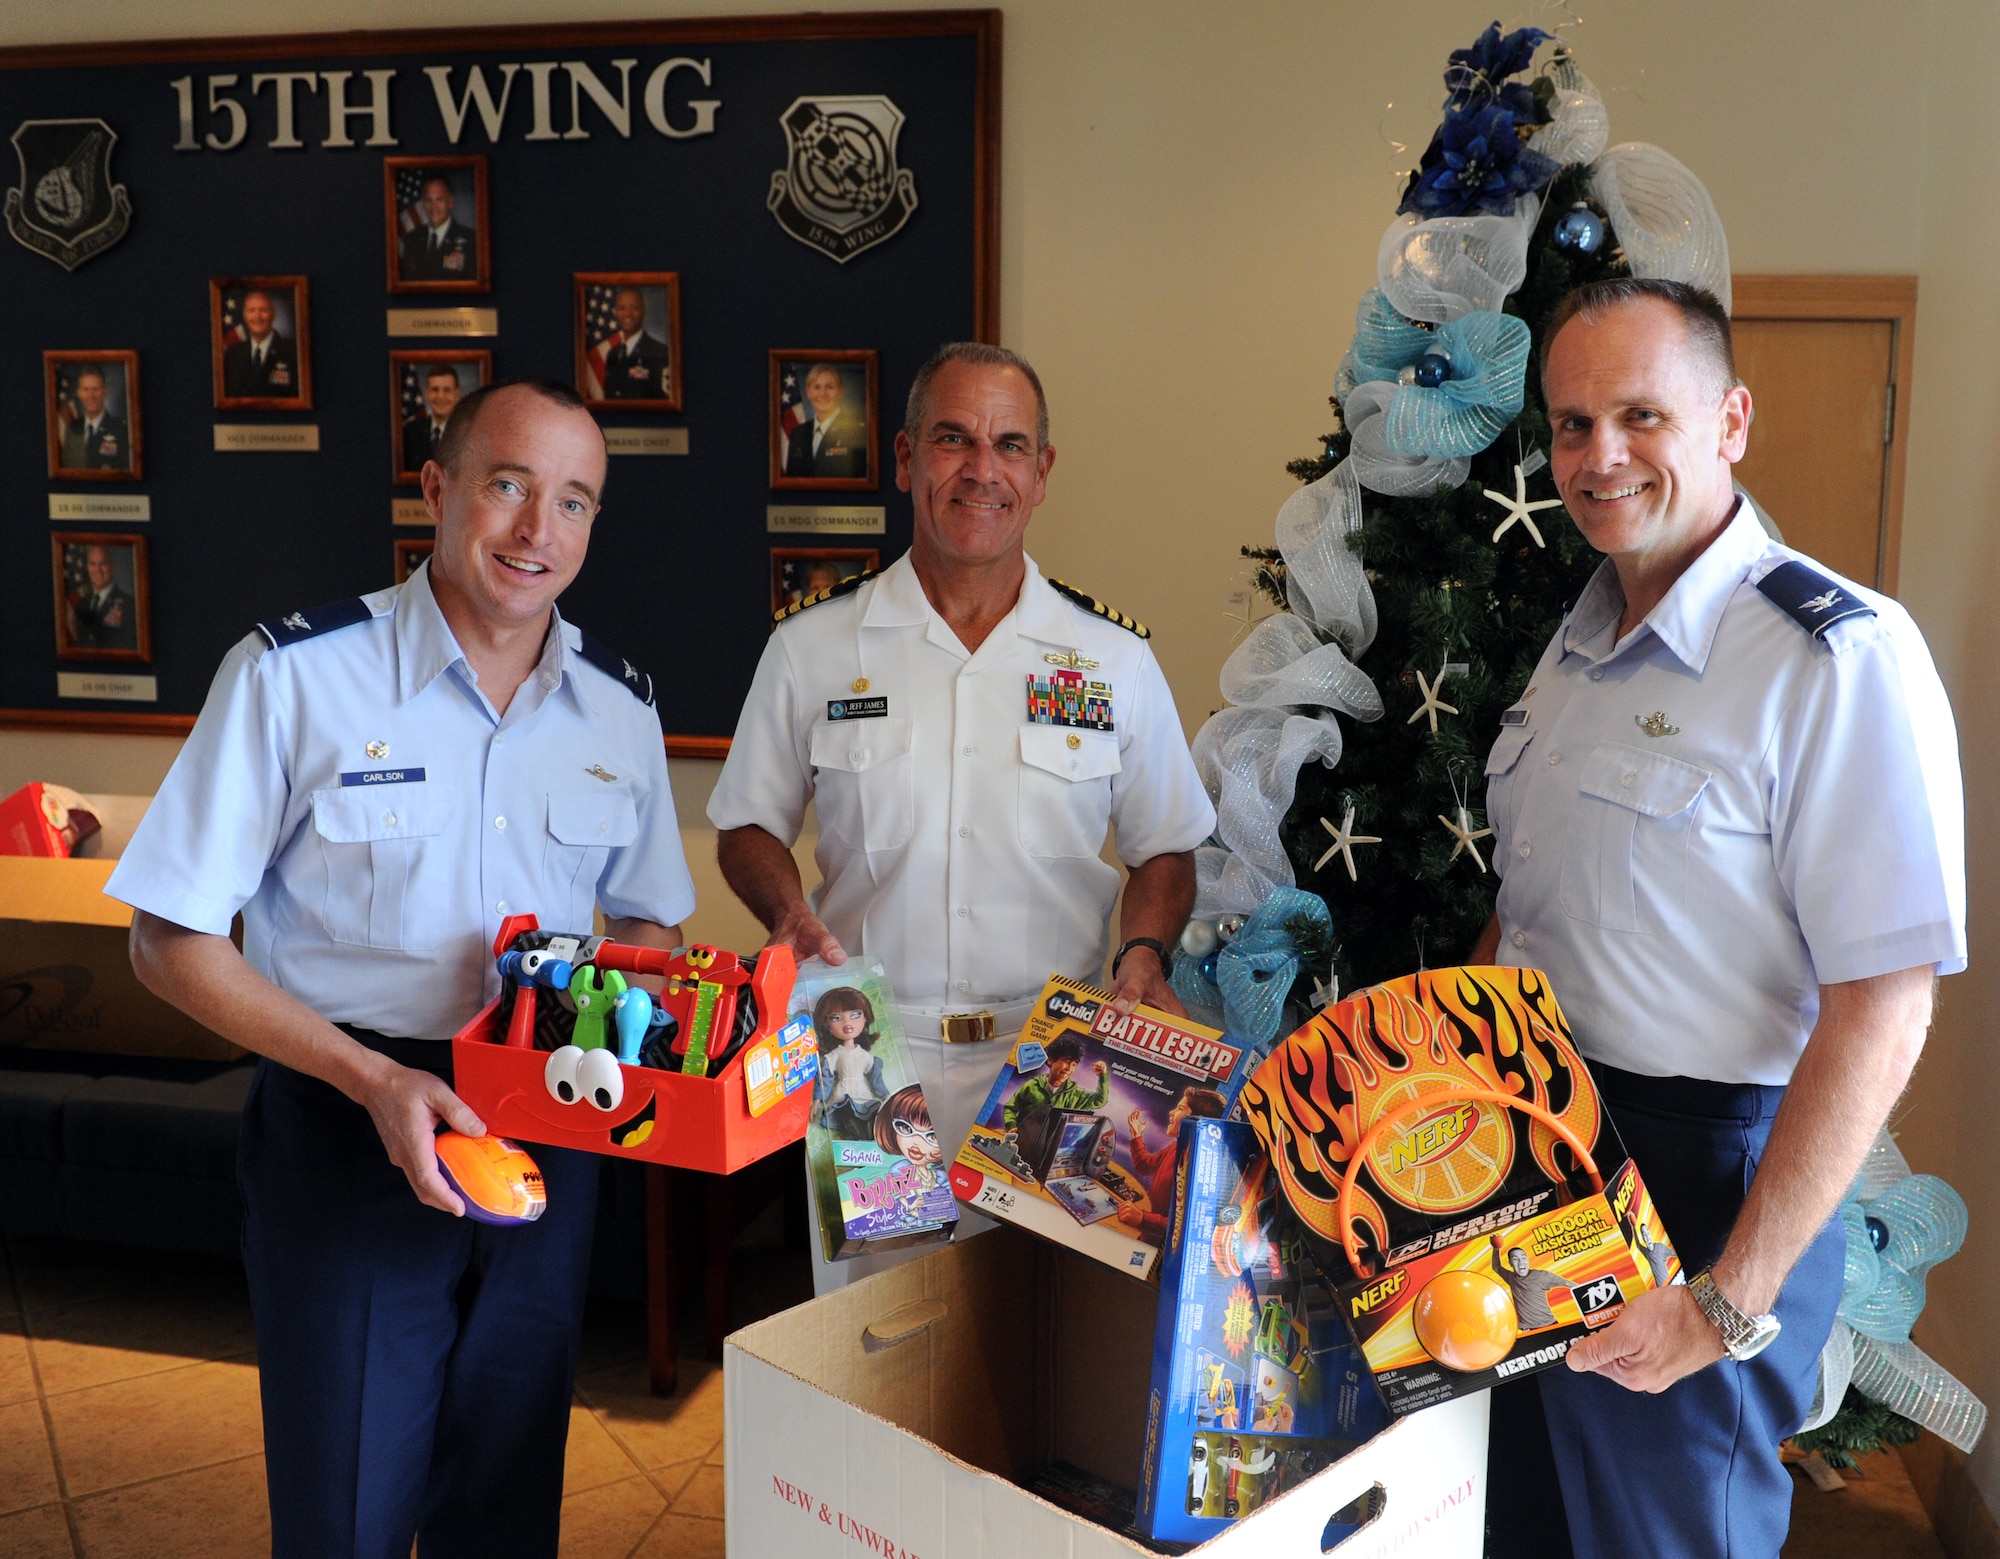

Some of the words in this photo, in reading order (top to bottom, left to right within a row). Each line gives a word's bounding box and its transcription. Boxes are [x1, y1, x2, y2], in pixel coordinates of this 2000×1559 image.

[171, 69, 398, 152] 15TH
[423, 57, 721, 146] WING
[844, 219, 886, 250] WING
[411, 318, 472, 329] COMMANDER
[788, 516, 812, 527] MDG
[813, 516, 880, 527] COMMANDER
[848, 702, 863, 711] JEFF
[863, 700, 885, 709] JAMES
[362, 771, 405, 783] CARLSON
[1048, 997, 1096, 1022] u-build
[1031, 1017, 1055, 1031] CHANGE
[1031, 1023, 1047, 1033] YOUR
[1095, 1008, 1233, 1074] BATTLESHIP
[1107, 1039, 1121, 1048] THE
[1122, 1044, 1153, 1059] TACTICAL
[1154, 1054, 1183, 1070] COMBAT
[1184, 1064, 1205, 1078] GAME
[1111, 1062, 1126, 1072] Build
[1125, 1067, 1138, 1077] your
[1139, 1072, 1150, 1080] own
[1112, 1069, 1123, 1078] and
[1123, 1073, 1143, 1086] destroy
[1143, 1080, 1153, 1089] the
[1153, 1083, 1174, 1096] enemy!
[1207, 1123, 1222, 1147] 3+
[1390, 1101, 1474, 1174] NERF
[955, 1177, 969, 1188] Kids
[986, 1185, 997, 1193] AGES
[1613, 1165, 1636, 1223] NERF
[981, 1192, 993, 1203] 7+
[865, 1208, 896, 1228] Style
[897, 1202, 910, 1215] it!
[1432, 1205, 1539, 1250] CLASSIC
[1434, 1191, 1550, 1242] NERFOOP
[1532, 1207, 1600, 1242] INDOOR
[1531, 1219, 1613, 1256] BASKETBALL
[1553, 1235, 1602, 1262] ACTION!
[1351, 1269, 1406, 1318] NERF
[1495, 1342, 1568, 1378] NERFOOP
[1346, 1370, 1358, 1383] 5
[1377, 1373, 1390, 1382] AGES
[1403, 1372, 1441, 1390] WARNING:
[1407, 1400, 1424, 1410] children
[1424, 1397, 1436, 1405] under
[772, 1475, 814, 1513] NEW
[818, 1503, 832, 1526] &
[1436, 1475, 1476, 1519] ONLY
